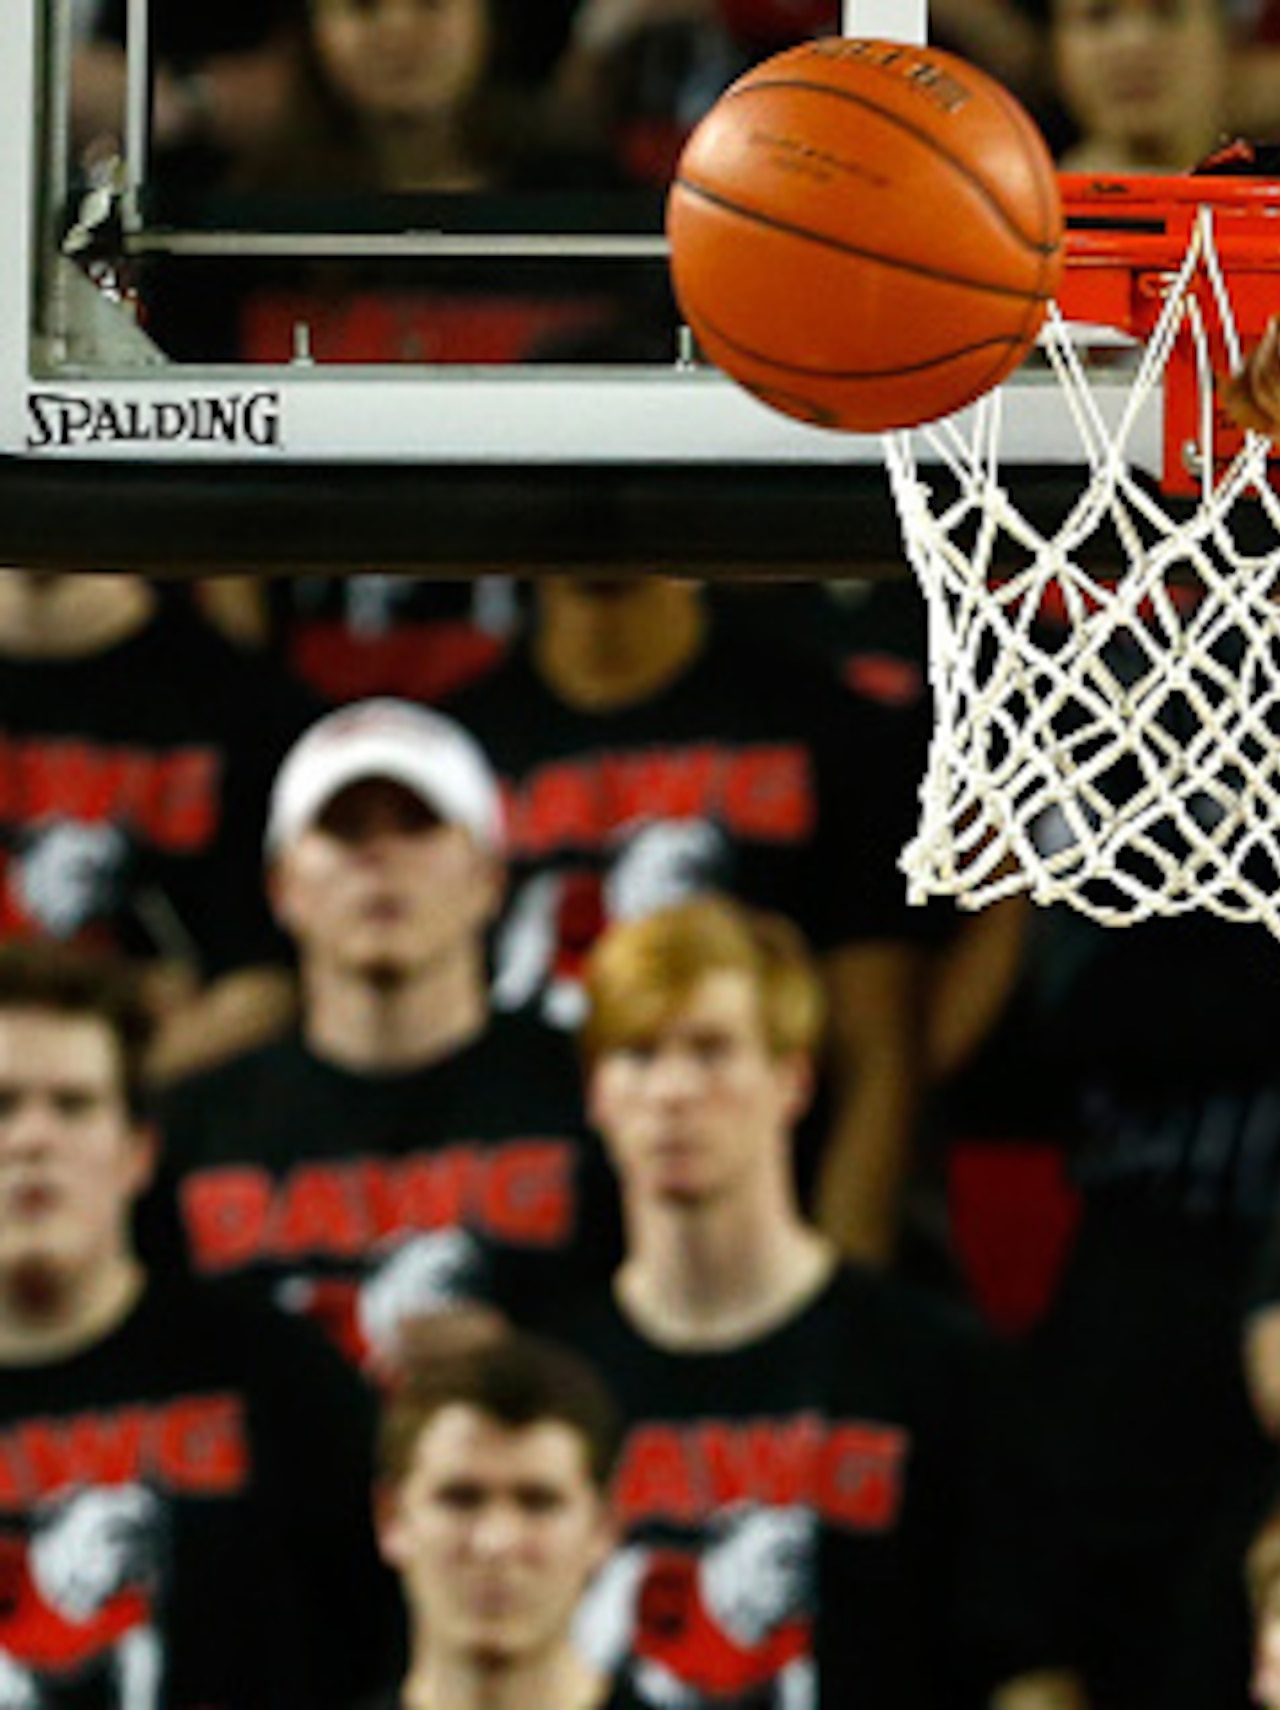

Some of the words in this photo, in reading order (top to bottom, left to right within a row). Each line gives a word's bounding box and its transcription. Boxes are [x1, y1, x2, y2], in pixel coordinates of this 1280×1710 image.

[26, 393, 282, 446] SPALDING
[182, 1139, 577, 1272] DAWG
[613, 1412, 907, 1531] AWG
